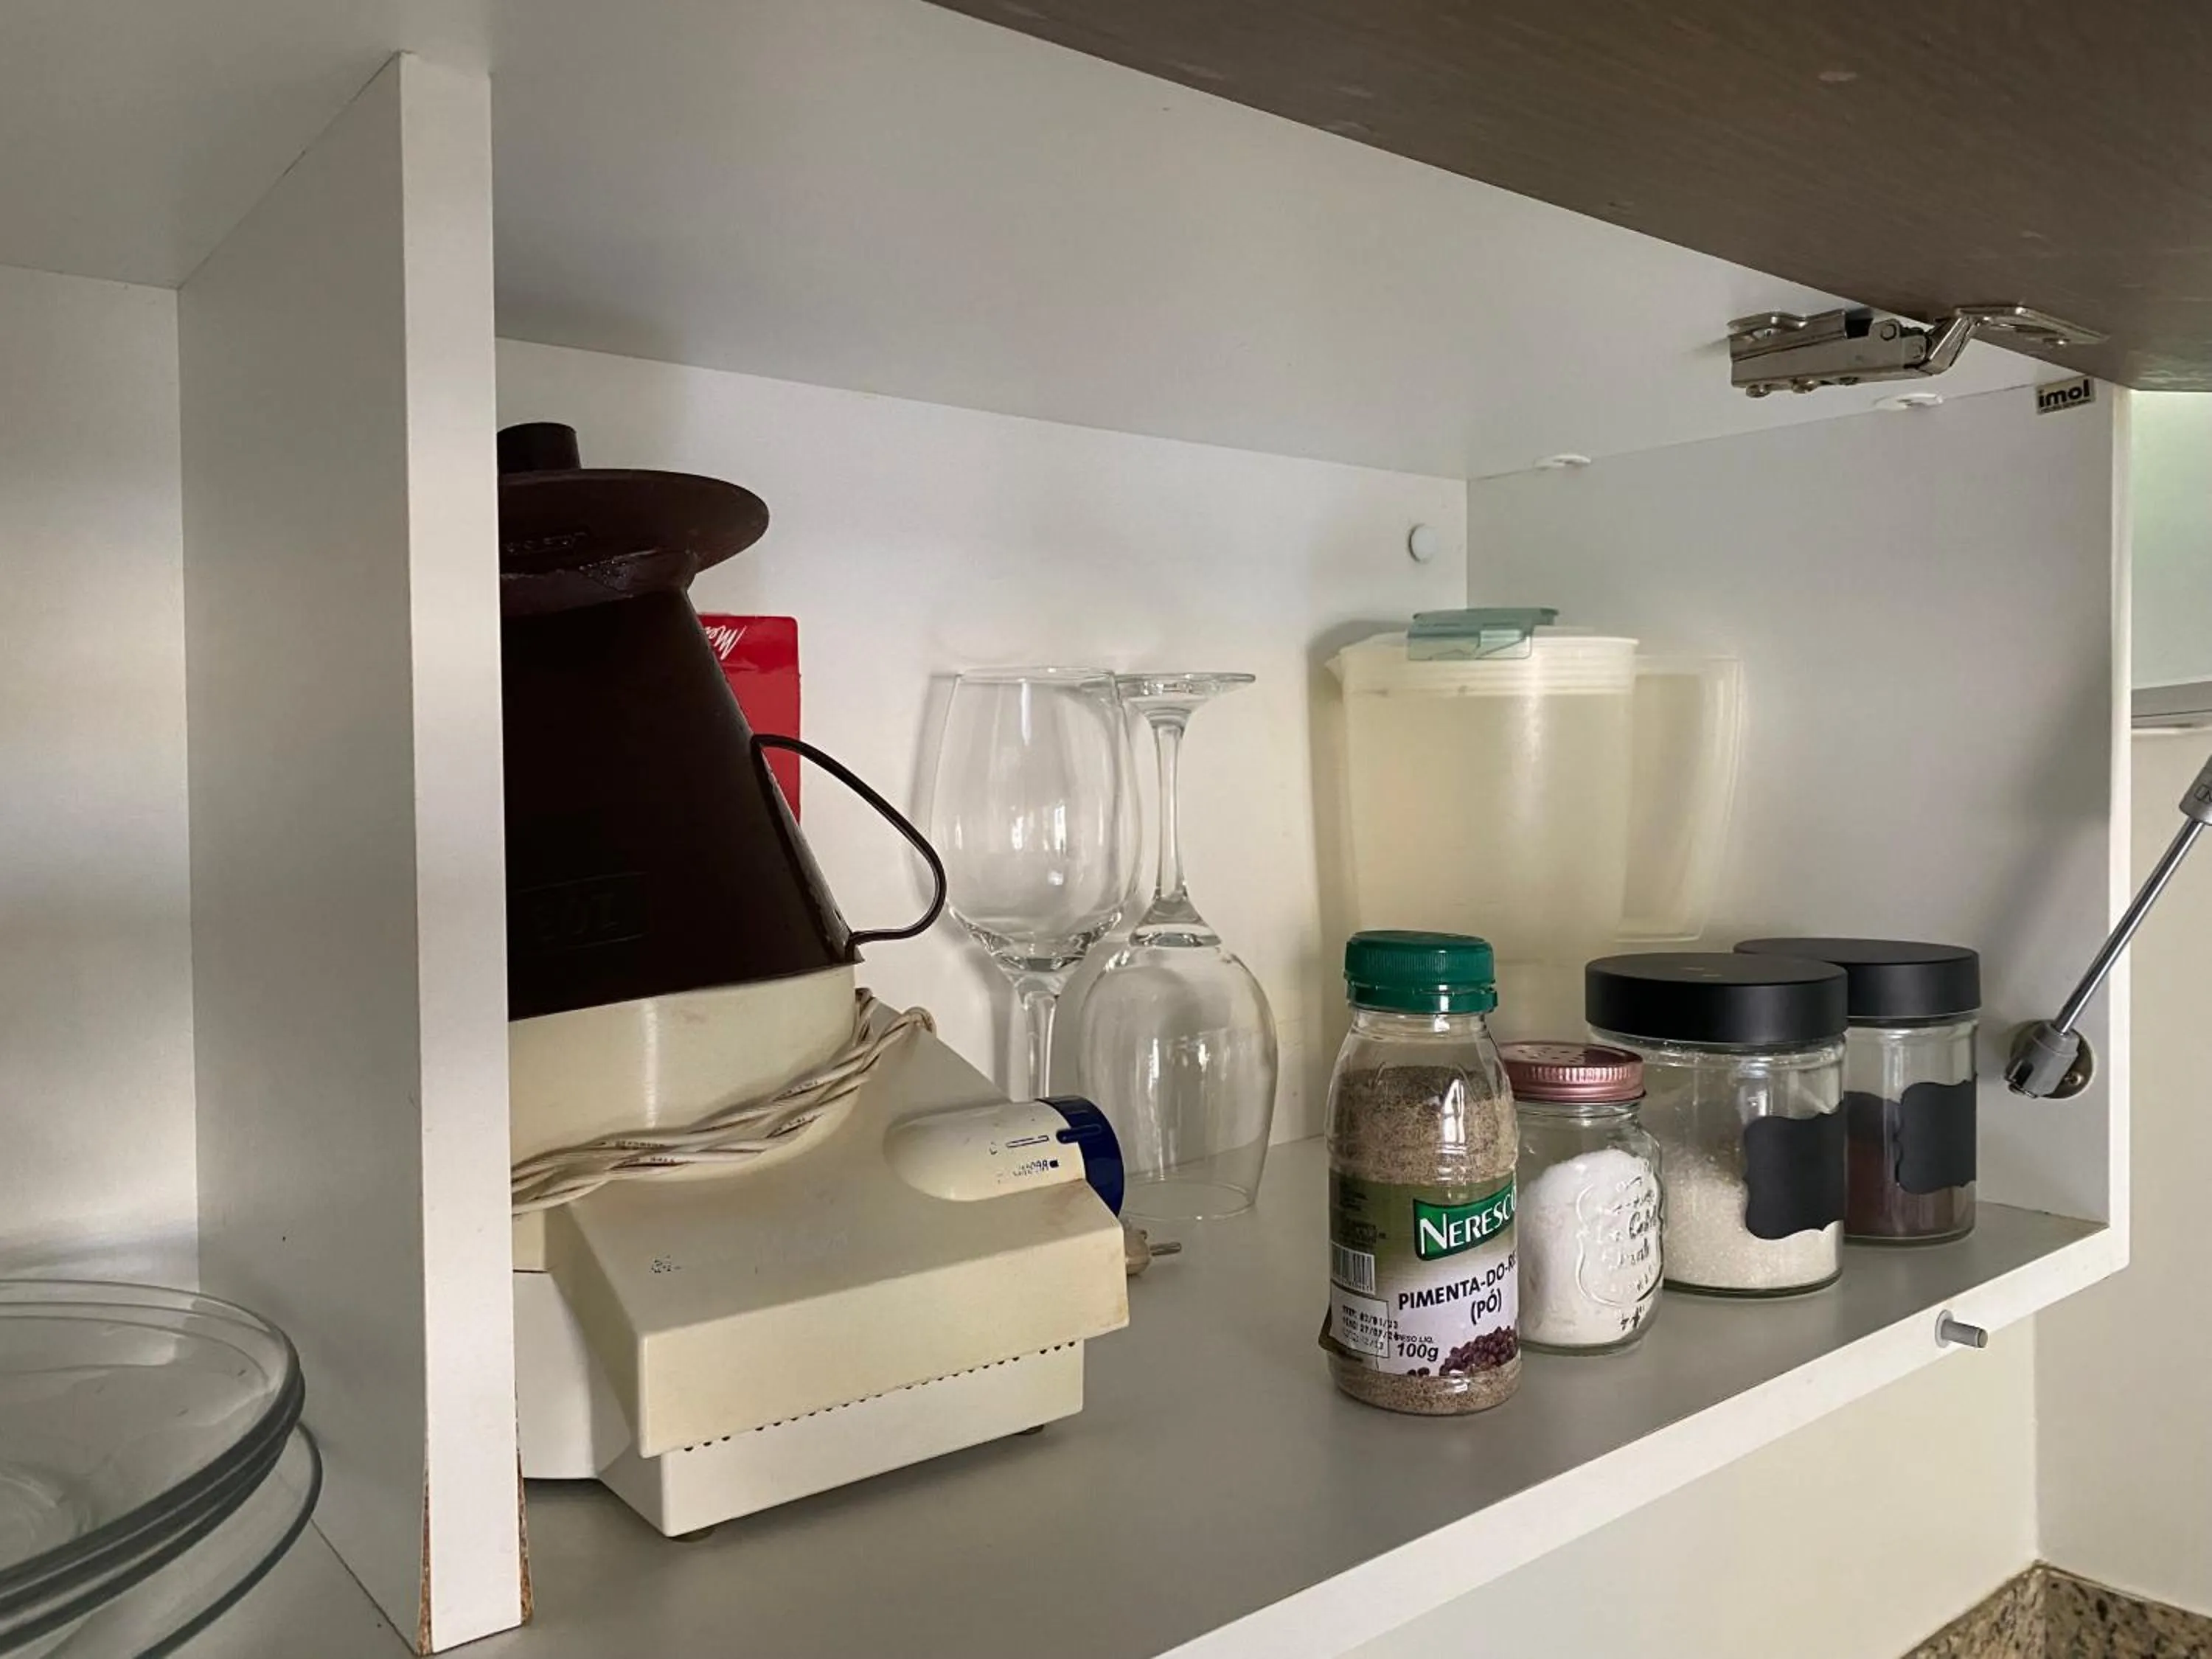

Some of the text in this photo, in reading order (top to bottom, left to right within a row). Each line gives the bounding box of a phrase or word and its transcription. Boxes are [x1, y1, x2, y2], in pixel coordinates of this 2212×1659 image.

[2038, 378, 2090, 408] imol
[1398, 1249, 1517, 1310] PIMENTA-DO-R
[1470, 1287, 1503, 1326] (PÓ)
[1397, 1342, 1439, 1362] 100g
